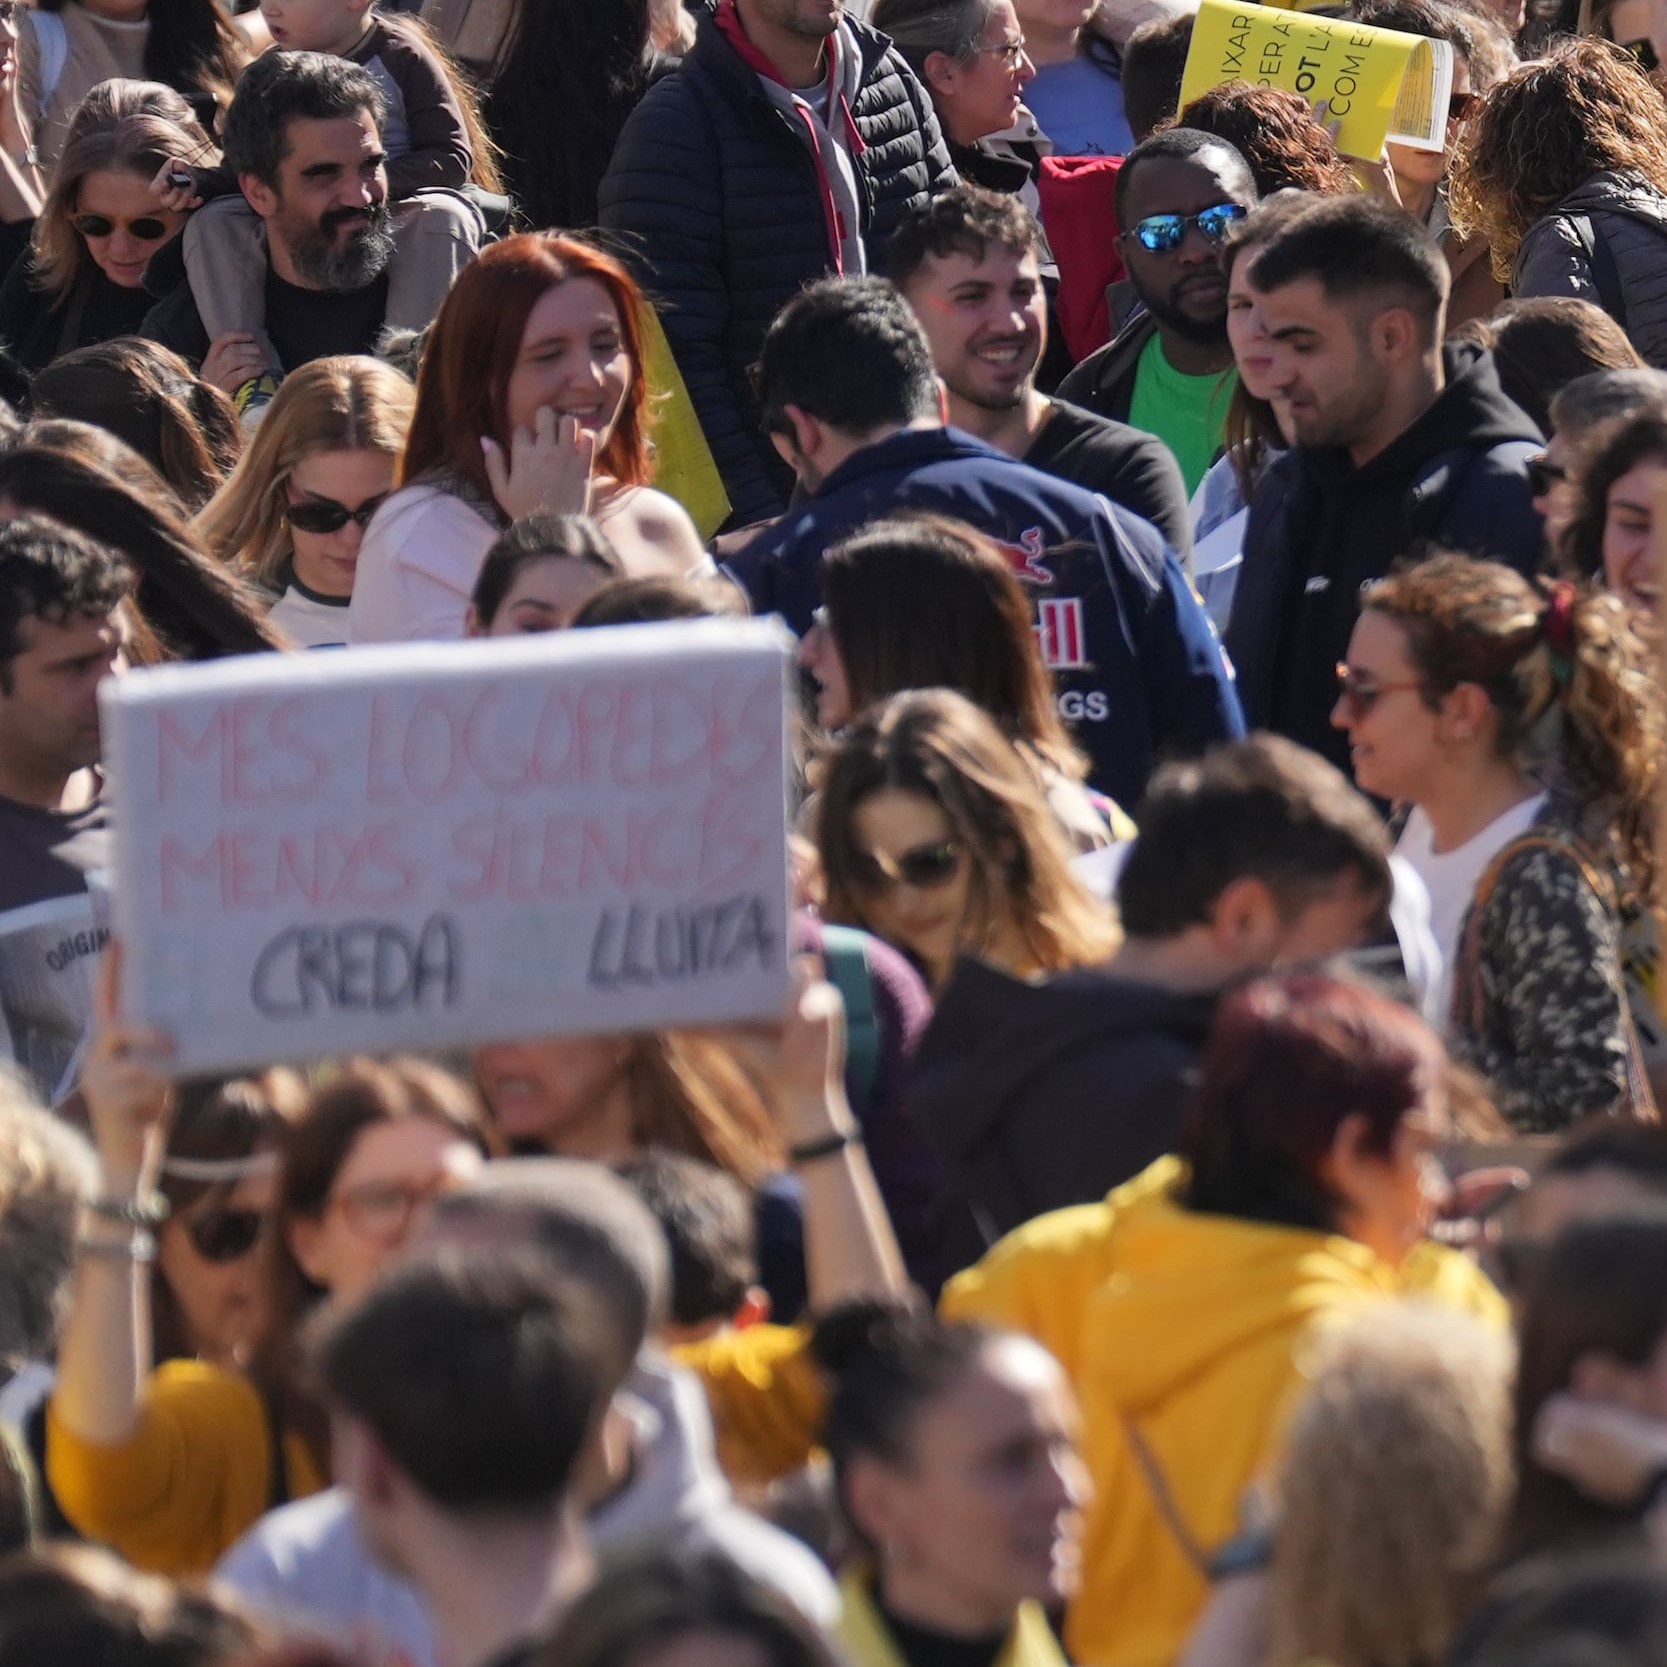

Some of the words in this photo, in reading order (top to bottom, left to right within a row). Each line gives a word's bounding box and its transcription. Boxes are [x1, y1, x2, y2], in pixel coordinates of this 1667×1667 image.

[1295, 56, 1321, 93] OT
[250, 910, 464, 1021] CREDA
[585, 891, 777, 992] LLUITA
